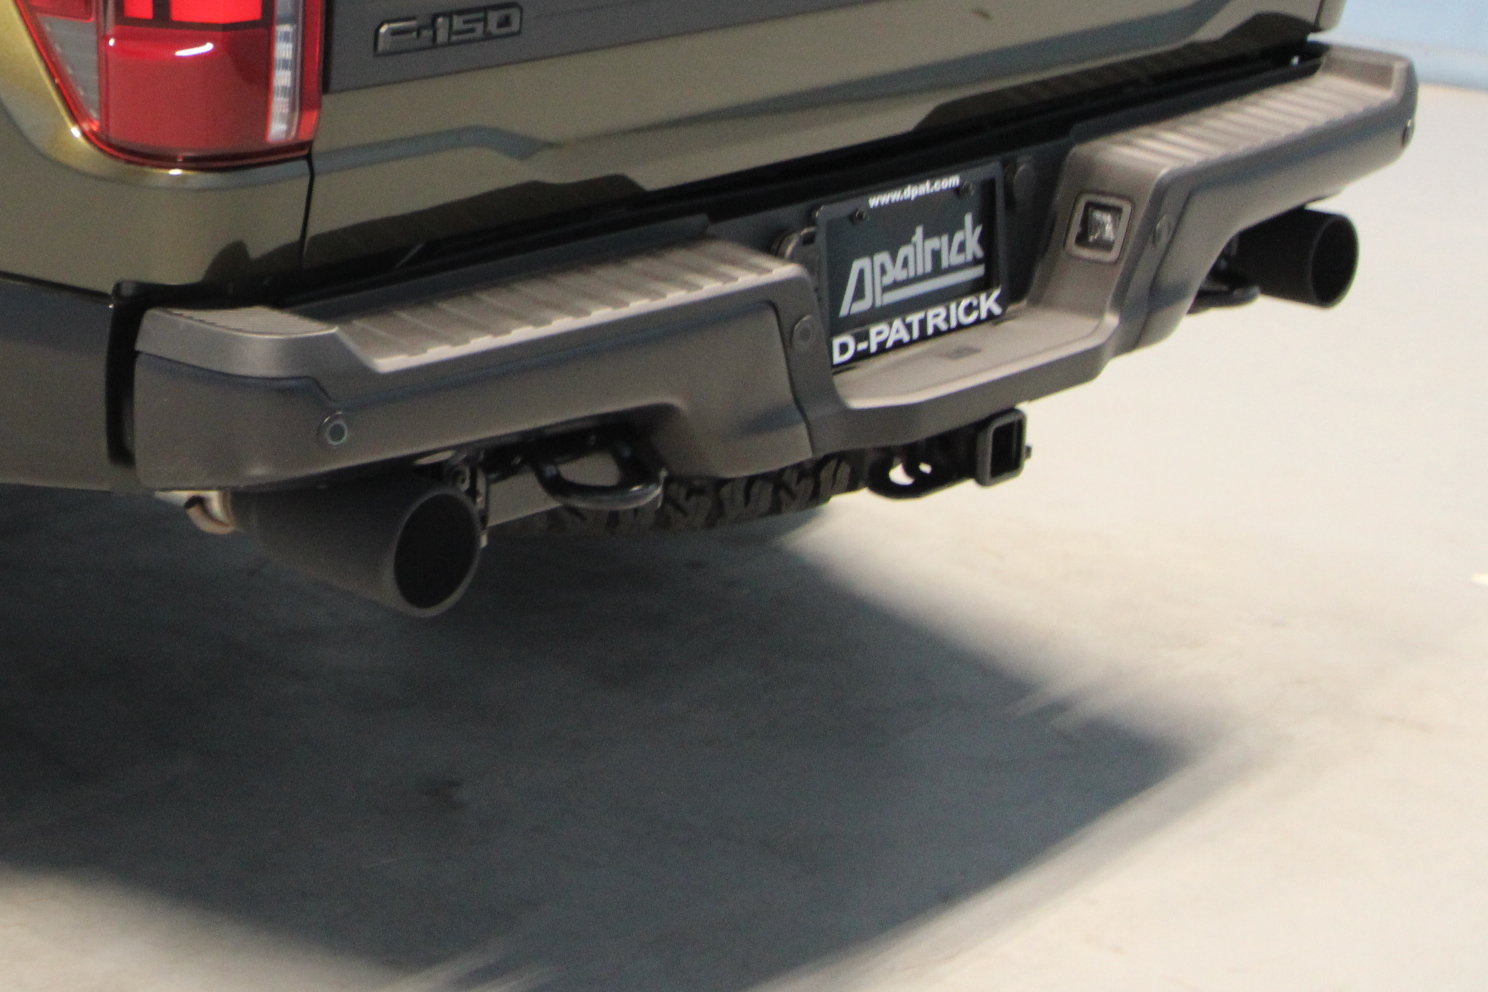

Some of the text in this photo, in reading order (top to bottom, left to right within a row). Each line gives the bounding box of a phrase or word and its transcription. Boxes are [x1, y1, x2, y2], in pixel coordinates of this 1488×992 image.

[374, 2, 523, 57] F-150
[868, 174, 961, 208] www.dpat.com
[832, 287, 1003, 365] D-PATRICK
